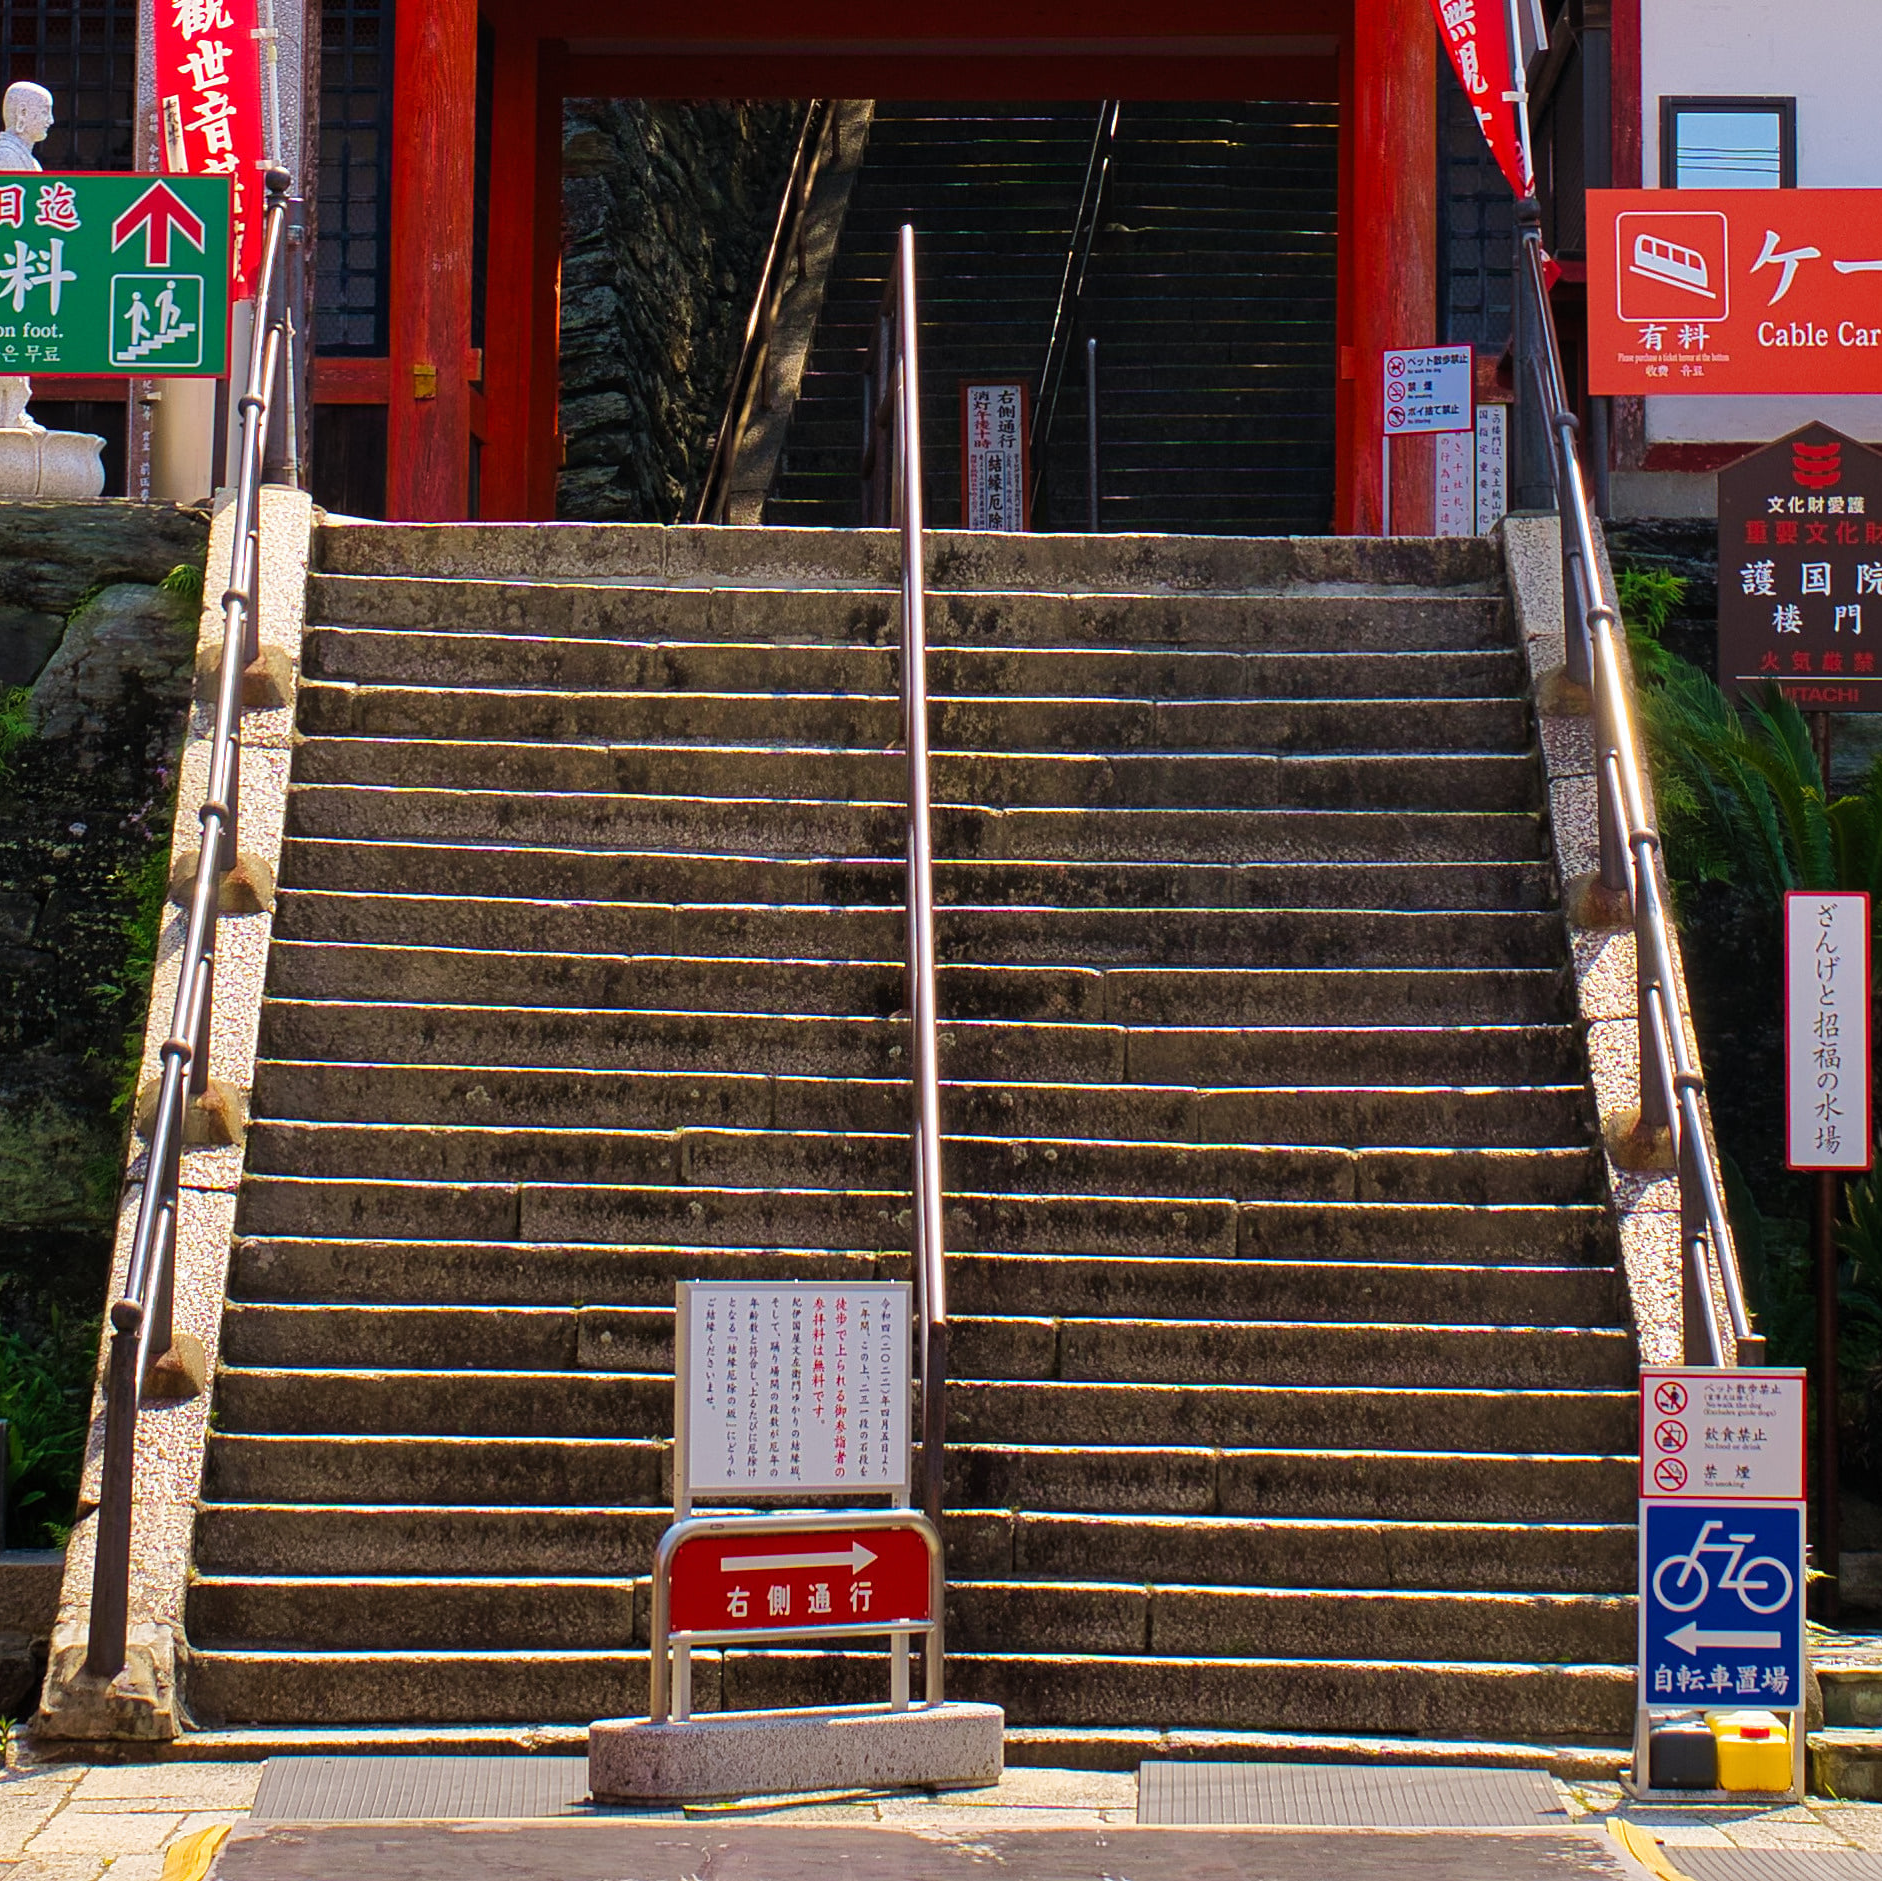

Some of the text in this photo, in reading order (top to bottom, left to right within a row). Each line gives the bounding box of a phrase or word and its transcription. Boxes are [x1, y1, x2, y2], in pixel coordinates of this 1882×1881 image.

[22, 321, 64, 339] foot.
[1637, 323, 1710, 351] 有料
[1758, 322, 1828, 346] Cable
[1837, 322, 1881, 346] Car
[25, 345, 61, 362] 무료
[998, 391, 1016, 449] 右側通行
[1768, 496, 1865, 514] 文化財愛護
[1771, 603, 1863, 635] 楼門
[1758, 652, 1875, 672] 火気厳禁
[1813, 903, 1844, 1155] ざんげと招福の水場
[812, 1296, 826, 1425] 参拝料は無料です。
[1705, 1427, 1767, 1442] 飲食禁止
[727, 1581, 873, 1619] 右側通行
[1654, 1664, 1790, 1697] 自転車置場
